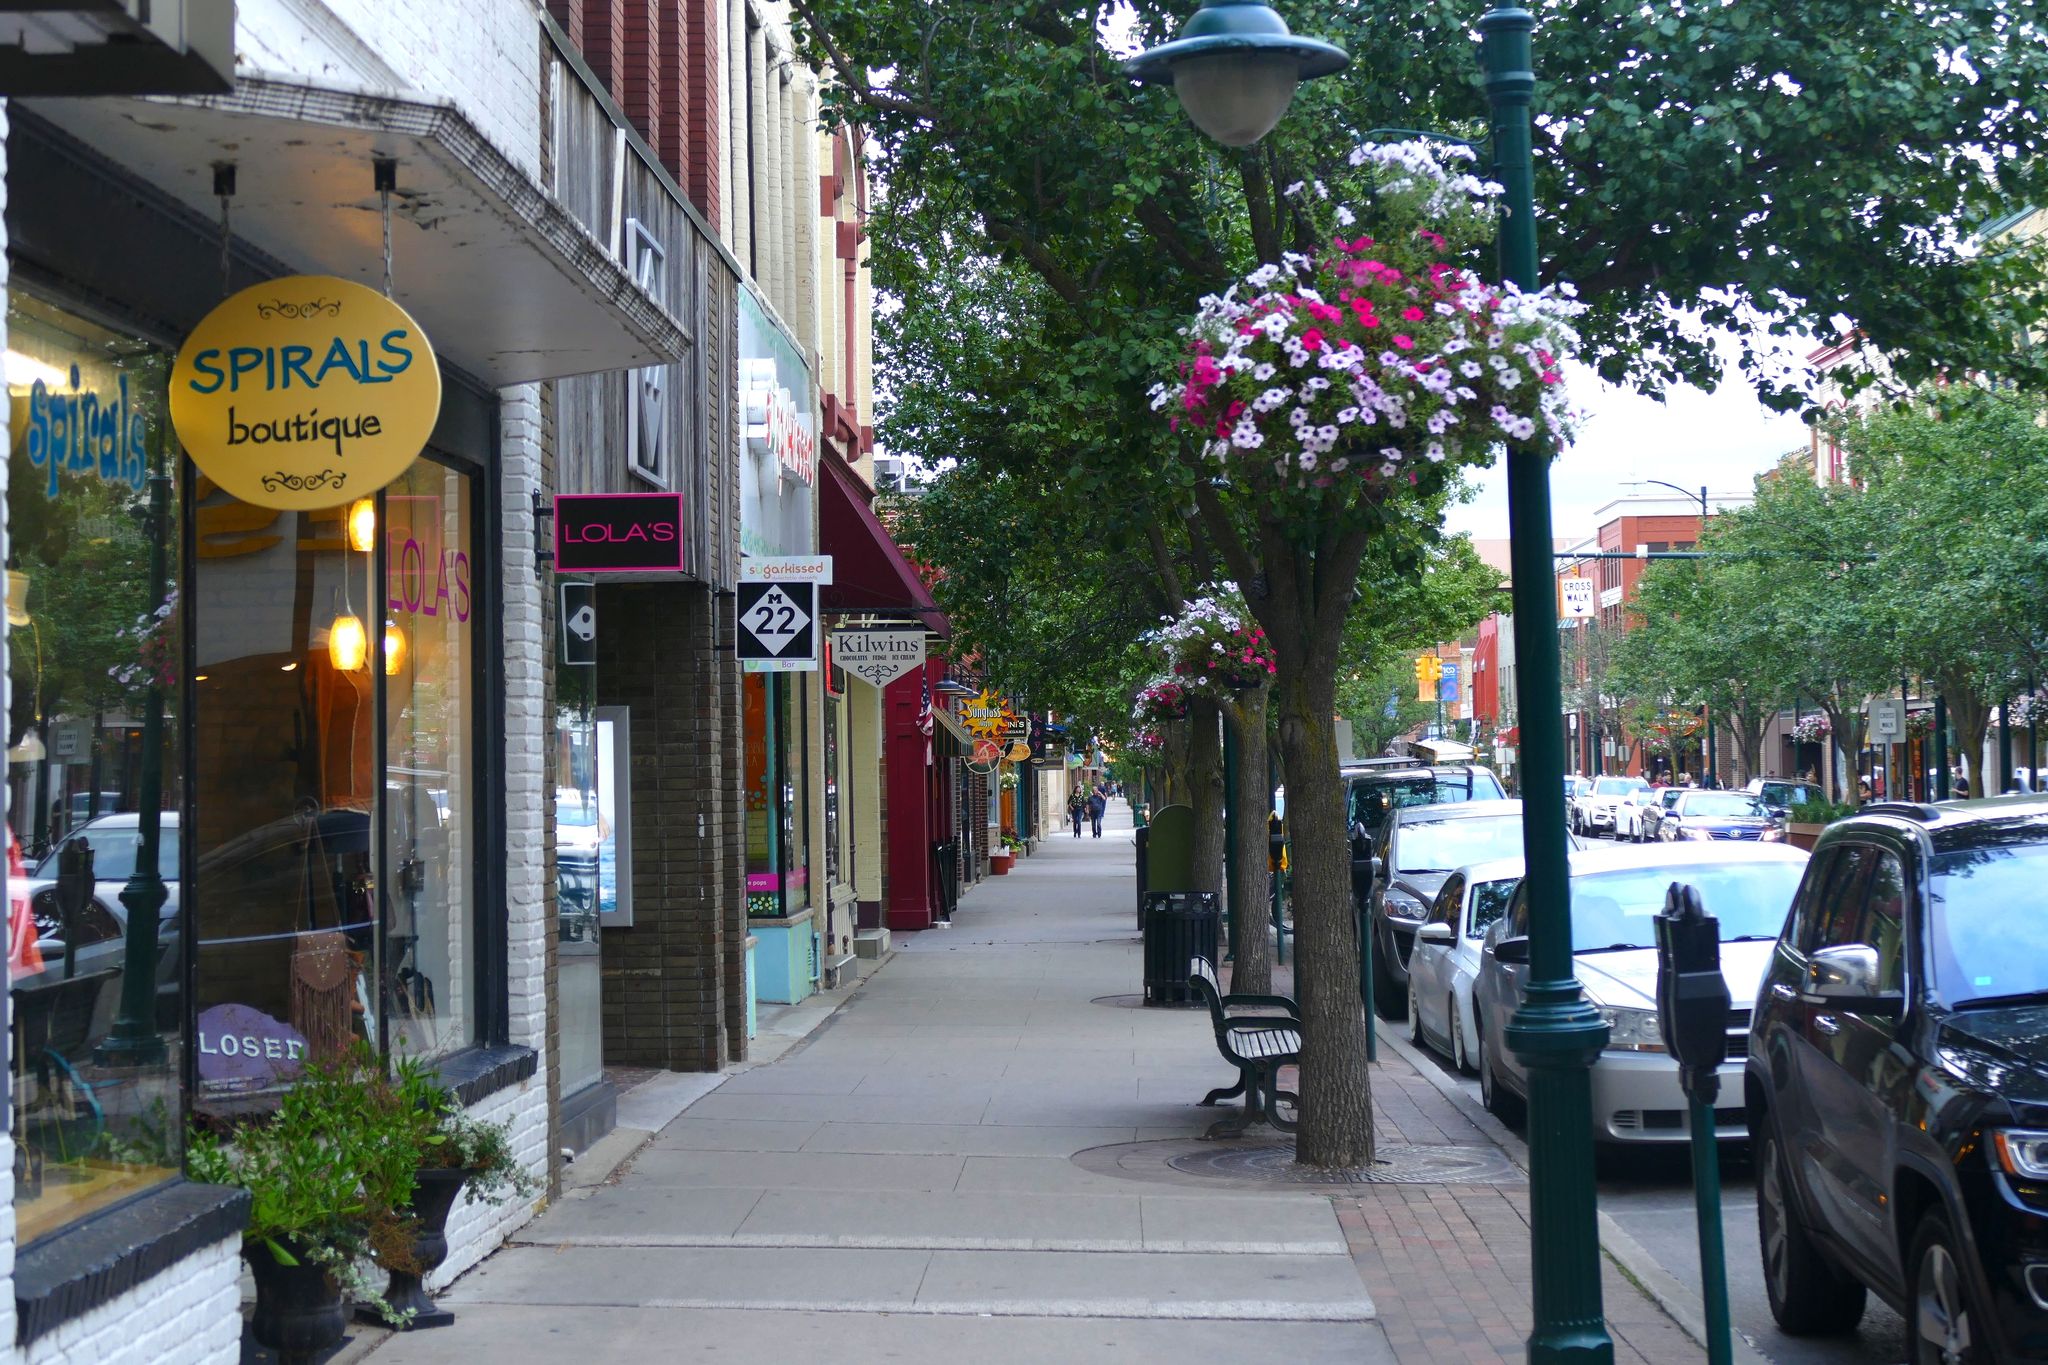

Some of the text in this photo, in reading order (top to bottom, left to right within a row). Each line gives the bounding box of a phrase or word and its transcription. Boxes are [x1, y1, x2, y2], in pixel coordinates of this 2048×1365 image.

[188, 329, 414, 394] SPIRALS
[226, 405, 383, 457] boutique
[563, 521, 675, 545] LOLA'S
[387, 530, 471, 624] LOLA'S
[1564, 581, 1592, 592] CROSS
[768, 594, 783, 605] M
[1567, 593, 1589, 602] WALK
[754, 605, 797, 635] 22
[837, 632, 920, 654] Kilwins
[781, 660, 796, 669] Bar
[968, 704, 1002, 721] Sunglass
[1008, 720, 1025, 728] INI'S
[752, 878, 768, 889] pops
[199, 1032, 303, 1060] LOSED
